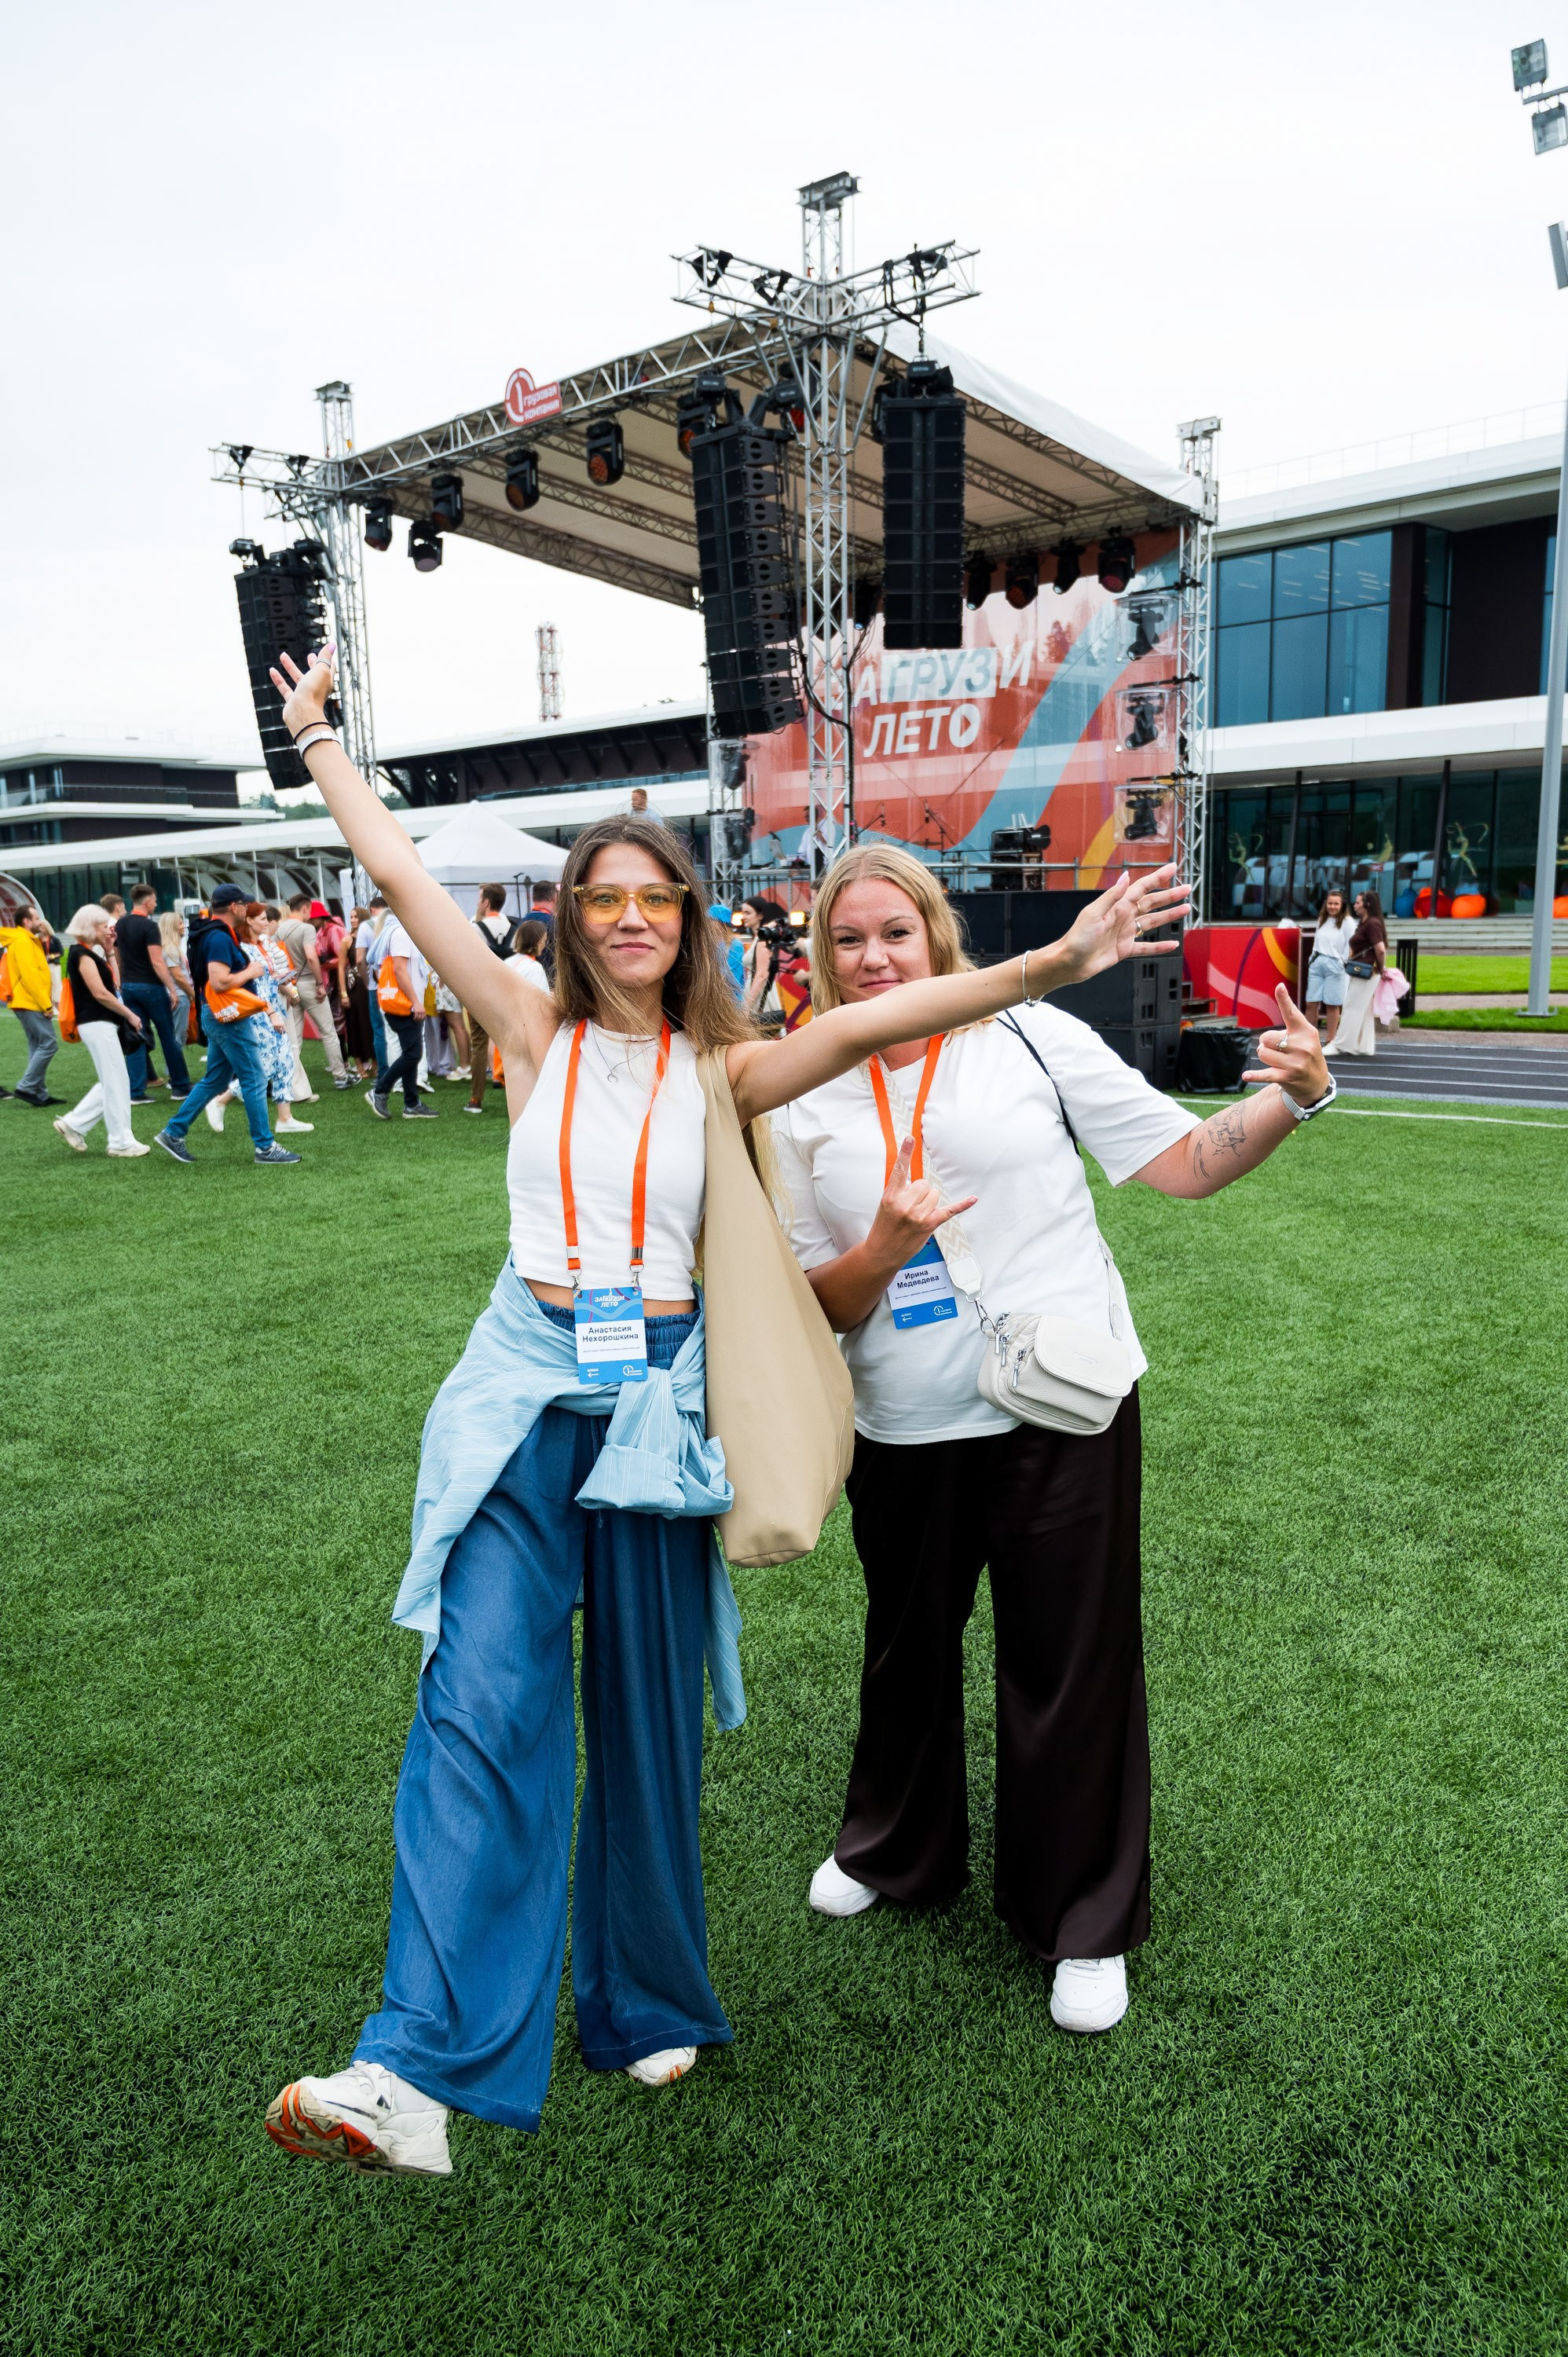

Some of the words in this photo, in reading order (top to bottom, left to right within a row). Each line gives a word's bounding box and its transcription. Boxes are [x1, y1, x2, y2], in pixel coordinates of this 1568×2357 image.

[863, 703, 981, 757] ЛЕТО
[904, 1270, 929, 1280] Ирина
[897, 1275, 940, 1289] Медведева
[588, 1325, 632, 1334] Анастасия
[583, 1333, 639, 1343] Нехорошкина
